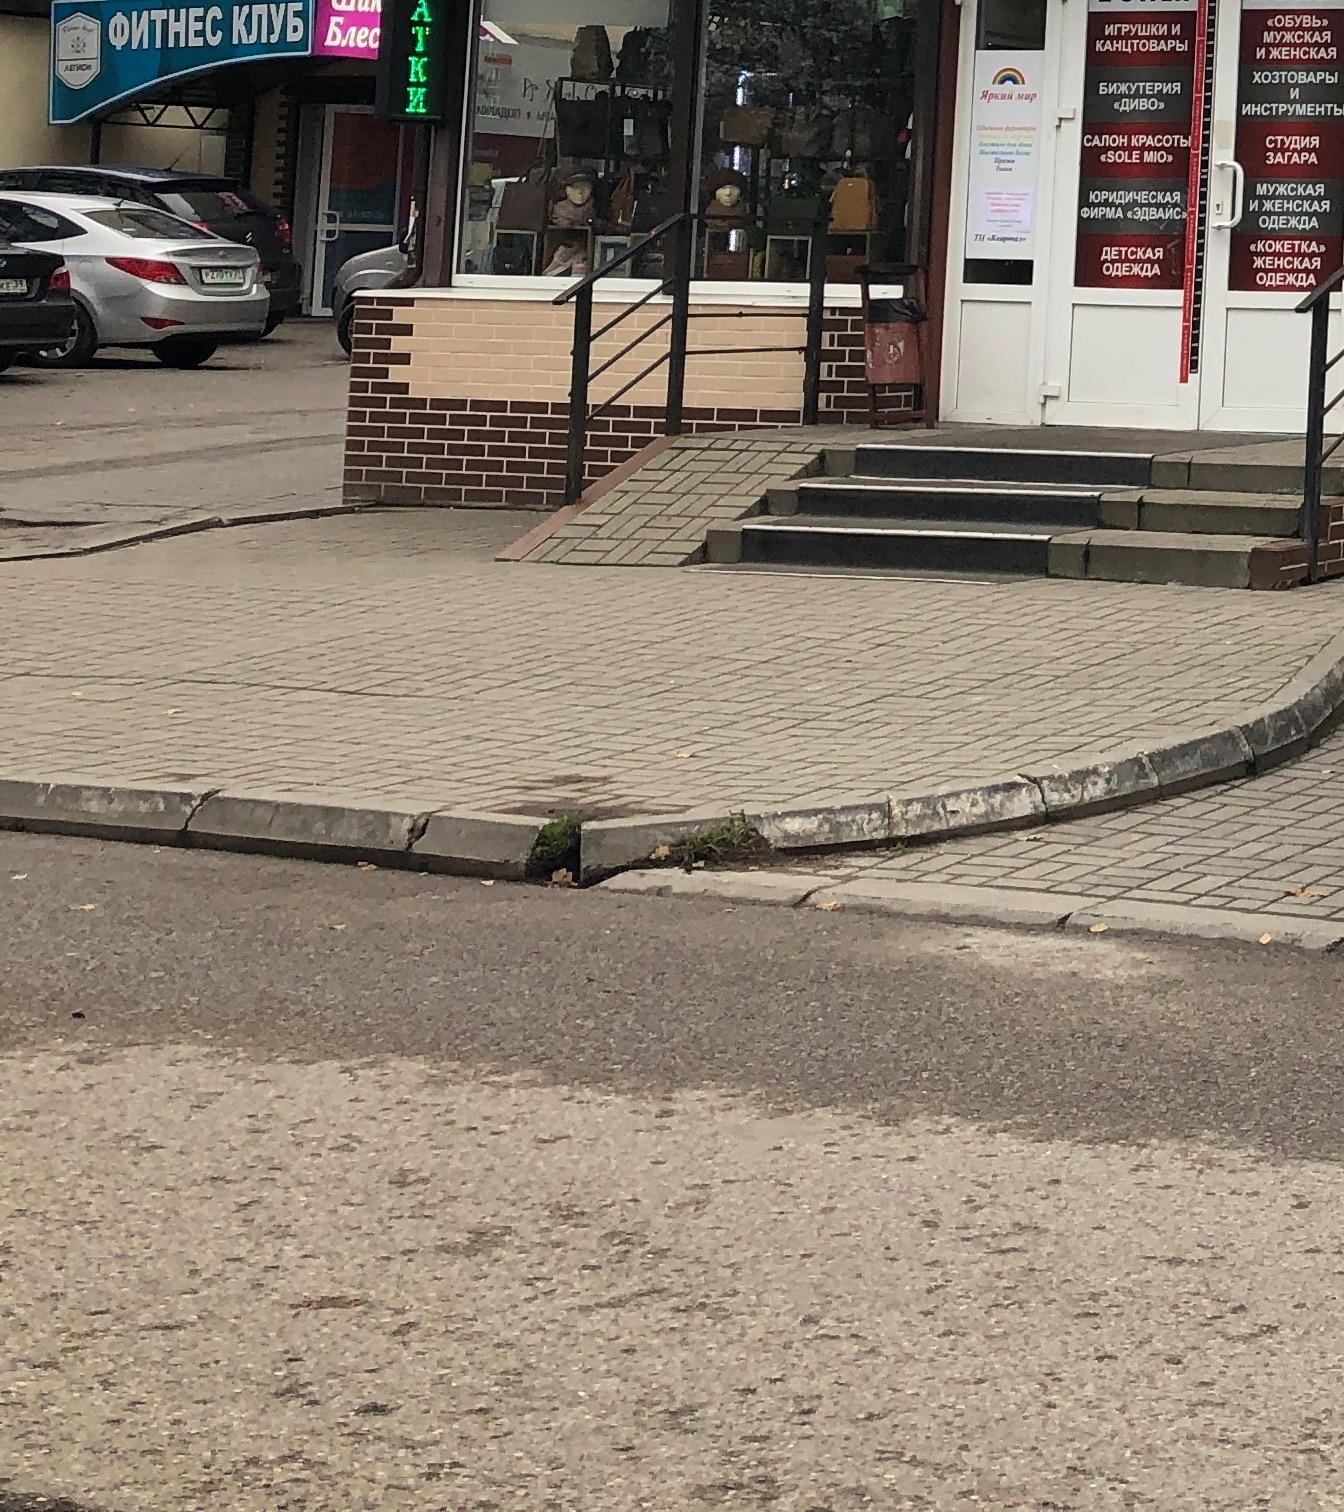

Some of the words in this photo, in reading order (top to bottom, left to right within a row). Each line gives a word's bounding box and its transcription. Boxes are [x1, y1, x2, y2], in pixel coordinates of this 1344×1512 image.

[108, 6, 223, 50] ФИТНЕС
[232, 2, 304, 46] КЛУБ
[1267, 15, 1329, 27] «ОБУВЬ»
[324, 16, 380, 49] Блес
[1104, 24, 1168, 36] ИГРУШКИ
[1171, 24, 1181, 36] И
[1263, 31, 1332, 44] МУЖСКАЯ
[1095, 40, 1189, 54] КАНЦТОВАРЫ
[1256, 47, 1266, 59] И
[1269, 47, 1337, 60] ЖЕНСКАЯ
[1252, 71, 1339, 84] ХОЗТОВАРЫ
[1099, 82, 1181, 95] БИЖУТЕРИЯ
[1289, 87, 1300, 100] И
[979, 90, 1014, 104] Яркий
[1113, 98, 1165, 112] «ДИВО»
[1083, 135, 1128, 147] САЛОН
[1131, 135, 1192, 148] КРАСОТЫ
[1265, 136, 1320, 150] СТУДИЯ
[1100, 151, 1141, 163] «SOLE
[1143, 151, 1173, 163] MIO»
[1265, 152, 1318, 165] ЗАГАРА
[1256, 183, 1325, 196] МУЖСКАЯ
[1089, 191, 1181, 205] ЮРИДИЧЕСКАЯ
[1080, 207, 1124, 219] ФИРМА
[1127, 204, 1188, 220] «ЭДВАЙС»
[1249, 200, 1259, 212] И
[1262, 200, 1331, 213] ЖЕНСКАЯ
[1258, 216, 1319, 230] ОДЕЖДА
[1249, 240, 1326, 253] «КОКЕТКА»
[1100, 247, 1164, 261] ДЕТСКАЯ
[1252, 257, 1321, 270] ЖЕНСКАЯ
[1102, 263, 1161, 278] ОДЕЖДА
[1256, 273, 1317, 287] ОДЕЖДА
